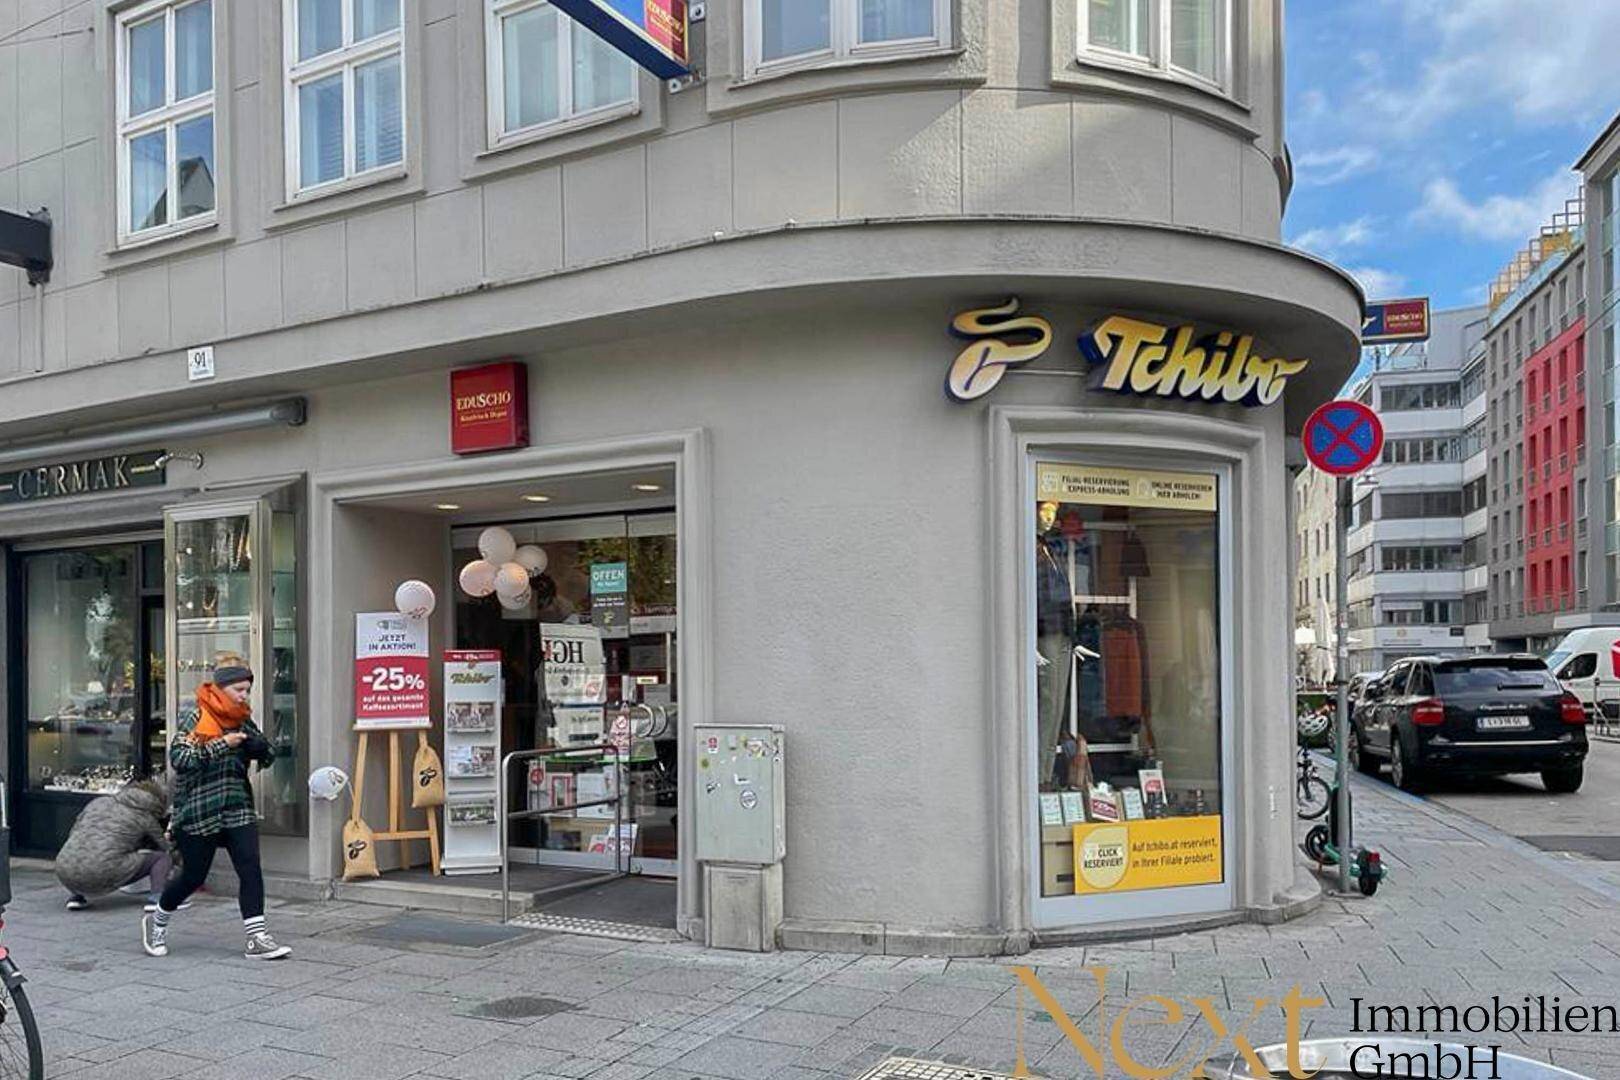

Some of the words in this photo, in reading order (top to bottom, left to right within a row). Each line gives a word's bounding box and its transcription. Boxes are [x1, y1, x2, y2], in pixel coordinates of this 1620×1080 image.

[194, 351, 206, 367] 91
[1092, 315, 1309, 405] Tchibo
[456, 390, 511, 411] EDUSCHO
[17, 455, 130, 499] CERMAK
[592, 569, 625, 581] OFFEN
[379, 634, 406, 642] JETZT
[381, 642, 417, 651] AKTION!
[362, 666, 425, 691] -25%
[377, 695, 391, 703] das
[392, 694, 425, 703] gesamte
[362, 703, 424, 712] Kaffeesortiment
[1132, 842, 1146, 851] Auf
[1097, 848, 1118, 857] CLICK
[1160, 855, 1182, 866] Filiale
